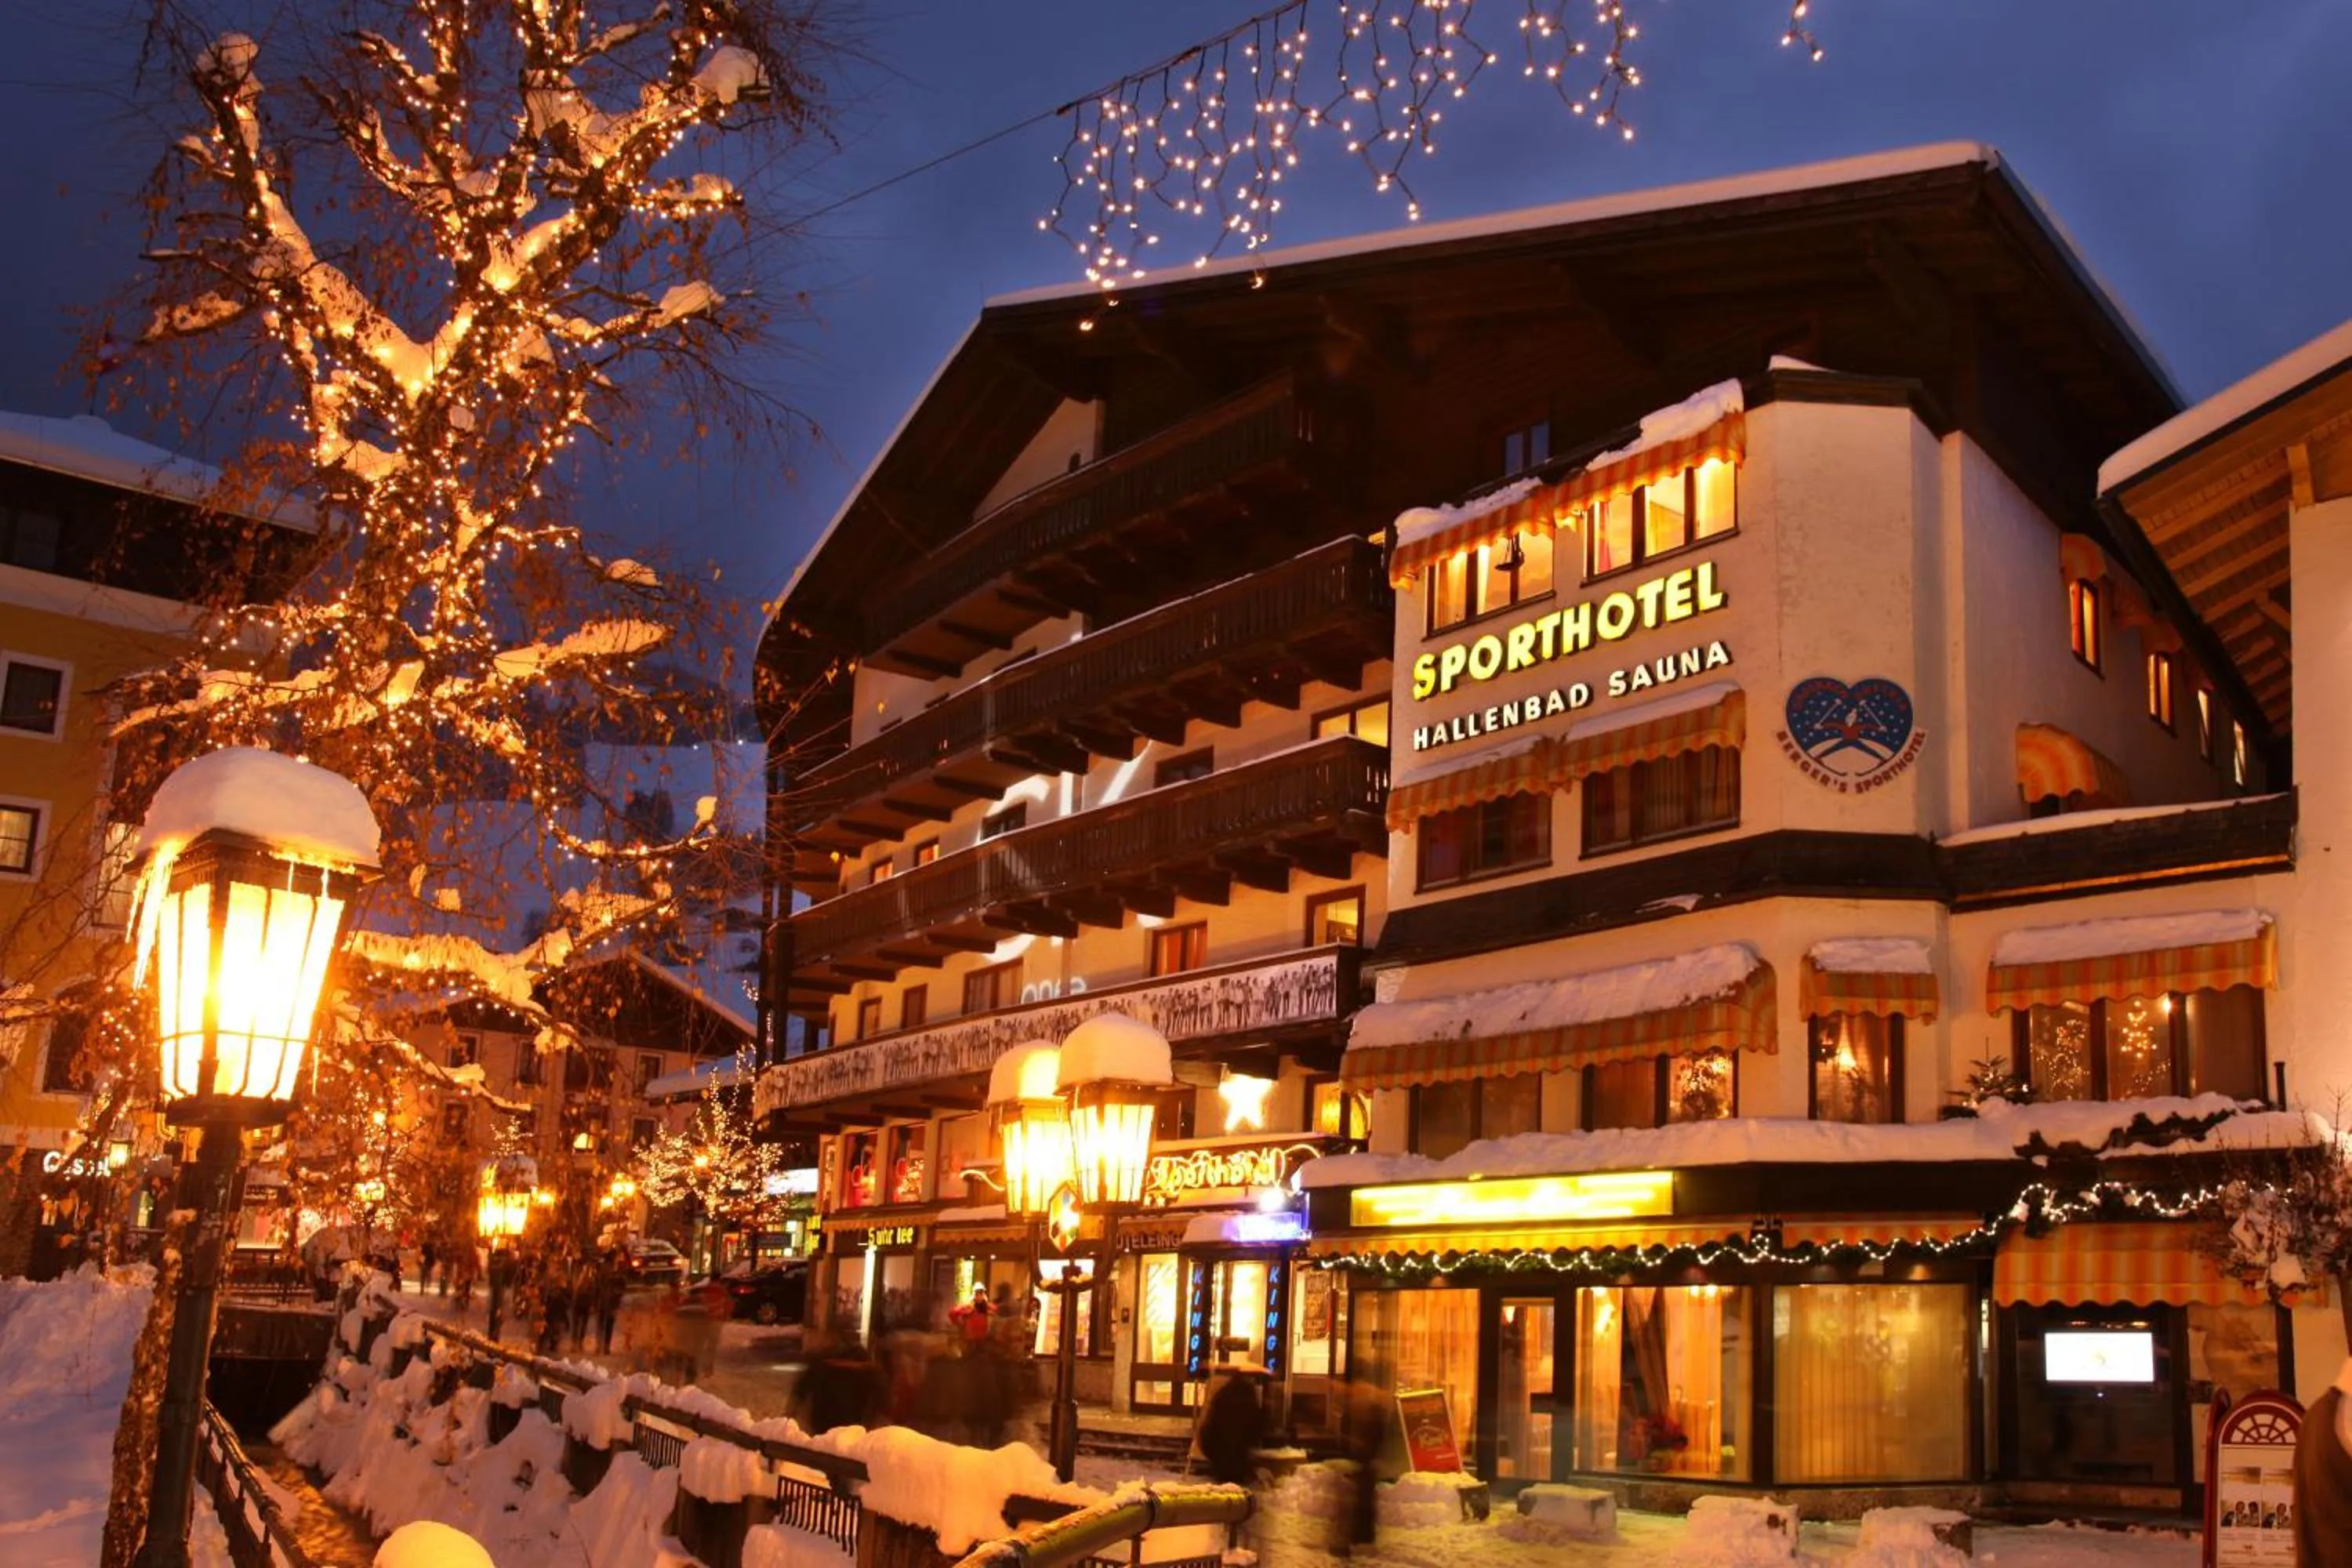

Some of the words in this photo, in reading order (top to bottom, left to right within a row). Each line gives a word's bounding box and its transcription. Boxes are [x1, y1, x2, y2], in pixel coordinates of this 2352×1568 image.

[1412, 561, 1726, 700] SPORTHOTEL
[1414, 682, 1590, 750] HALLENBAD
[1607, 641, 1730, 698] SAUNA
[1776, 730, 1847, 794] BERGER'S
[1854, 729, 1926, 794] SPORTHOTEL
[1189, 1266, 1203, 1373] KINGS
